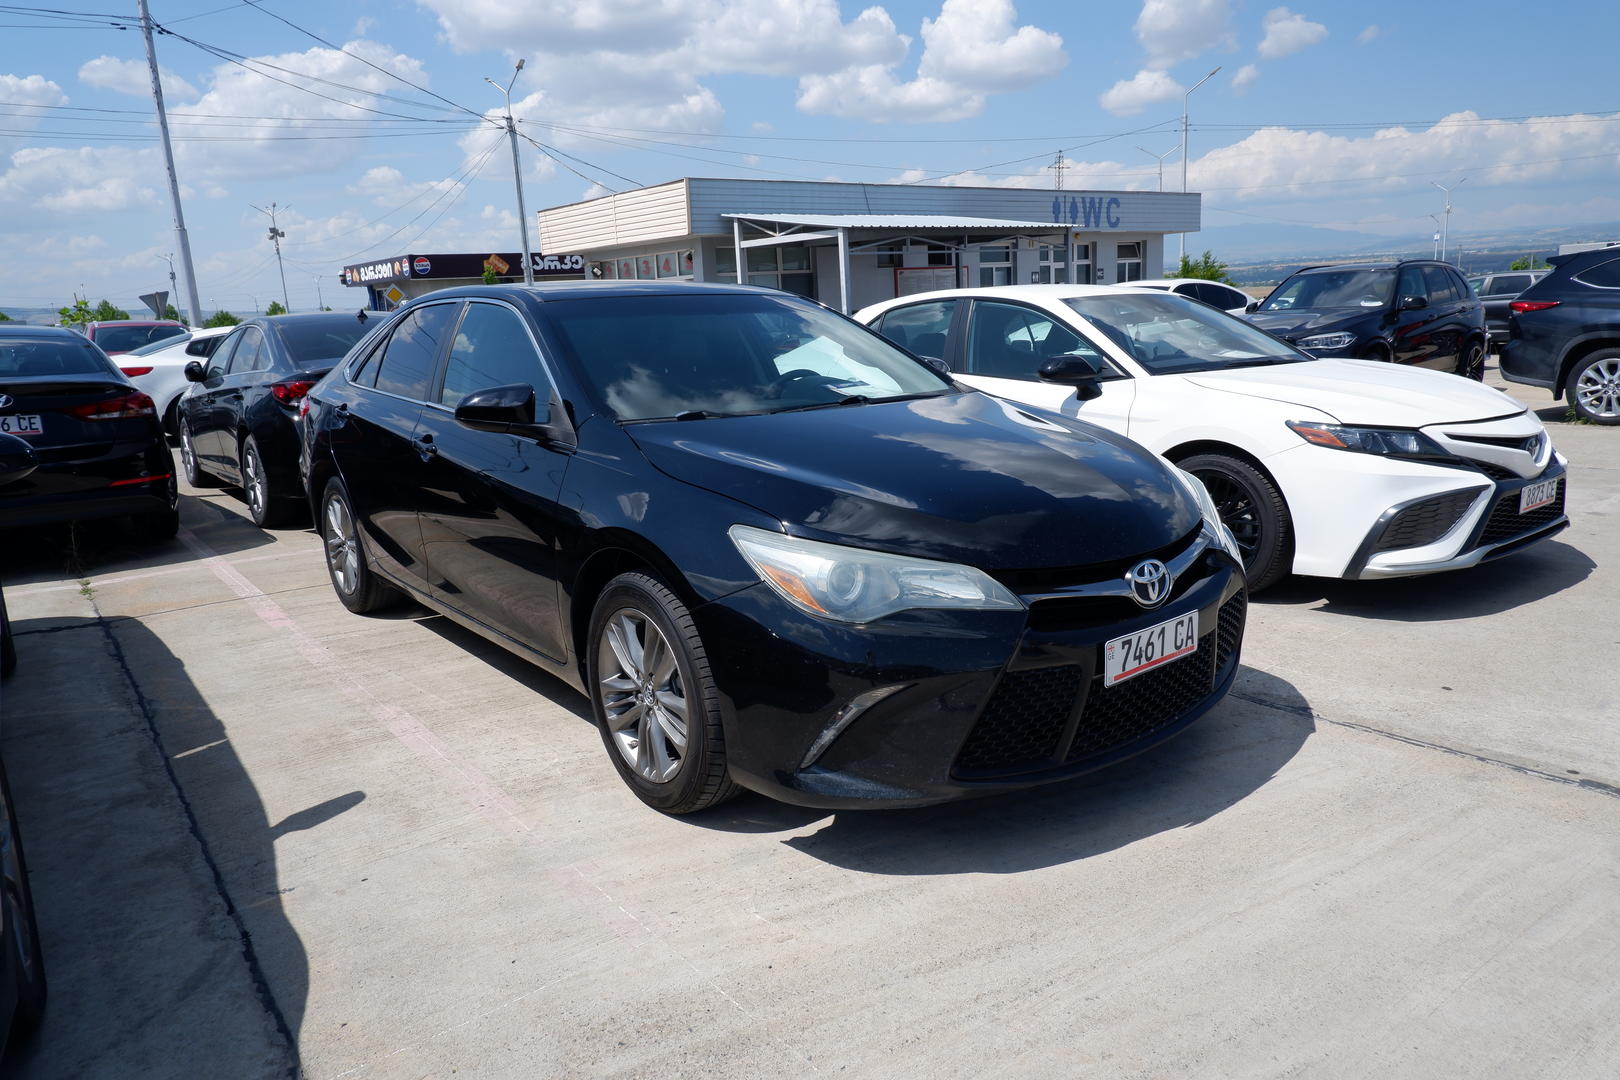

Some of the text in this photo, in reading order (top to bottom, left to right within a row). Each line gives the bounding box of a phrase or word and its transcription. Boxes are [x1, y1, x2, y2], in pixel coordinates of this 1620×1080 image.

[1081, 196, 1121, 229] WC
[520, 255, 585, 271] არკე
[623, 262, 631, 277] 2
[642, 260, 651, 275] 3
[662, 257, 671, 273] 4
[17, 416, 39, 431] CE
[1526, 480, 1556, 506] 8873 CE
[1121, 616, 1195, 672] 7461 CA
